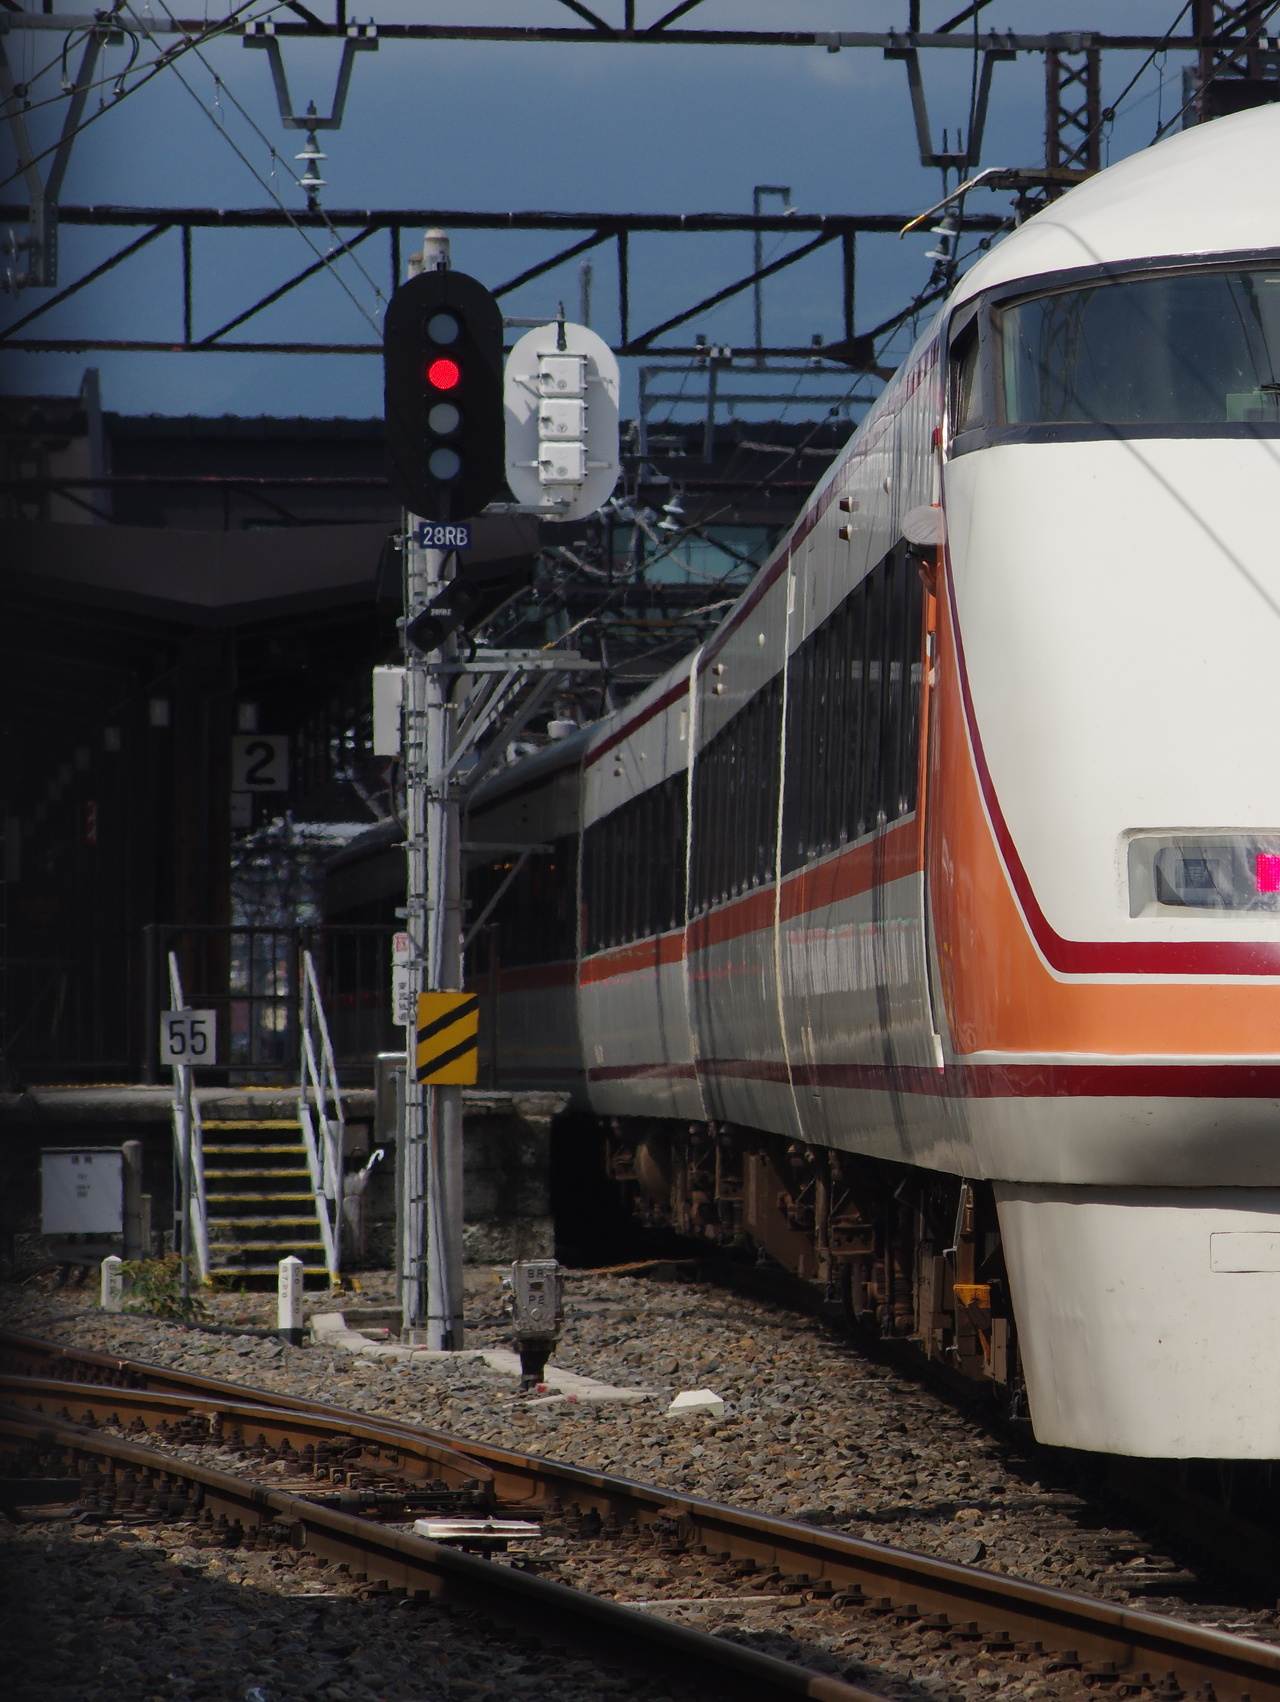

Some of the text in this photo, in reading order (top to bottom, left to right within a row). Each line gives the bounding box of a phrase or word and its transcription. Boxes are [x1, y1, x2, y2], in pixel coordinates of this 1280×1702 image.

[423, 526, 468, 546] 28RB
[246, 741, 275, 784] 2
[169, 1020, 207, 1055] 55
